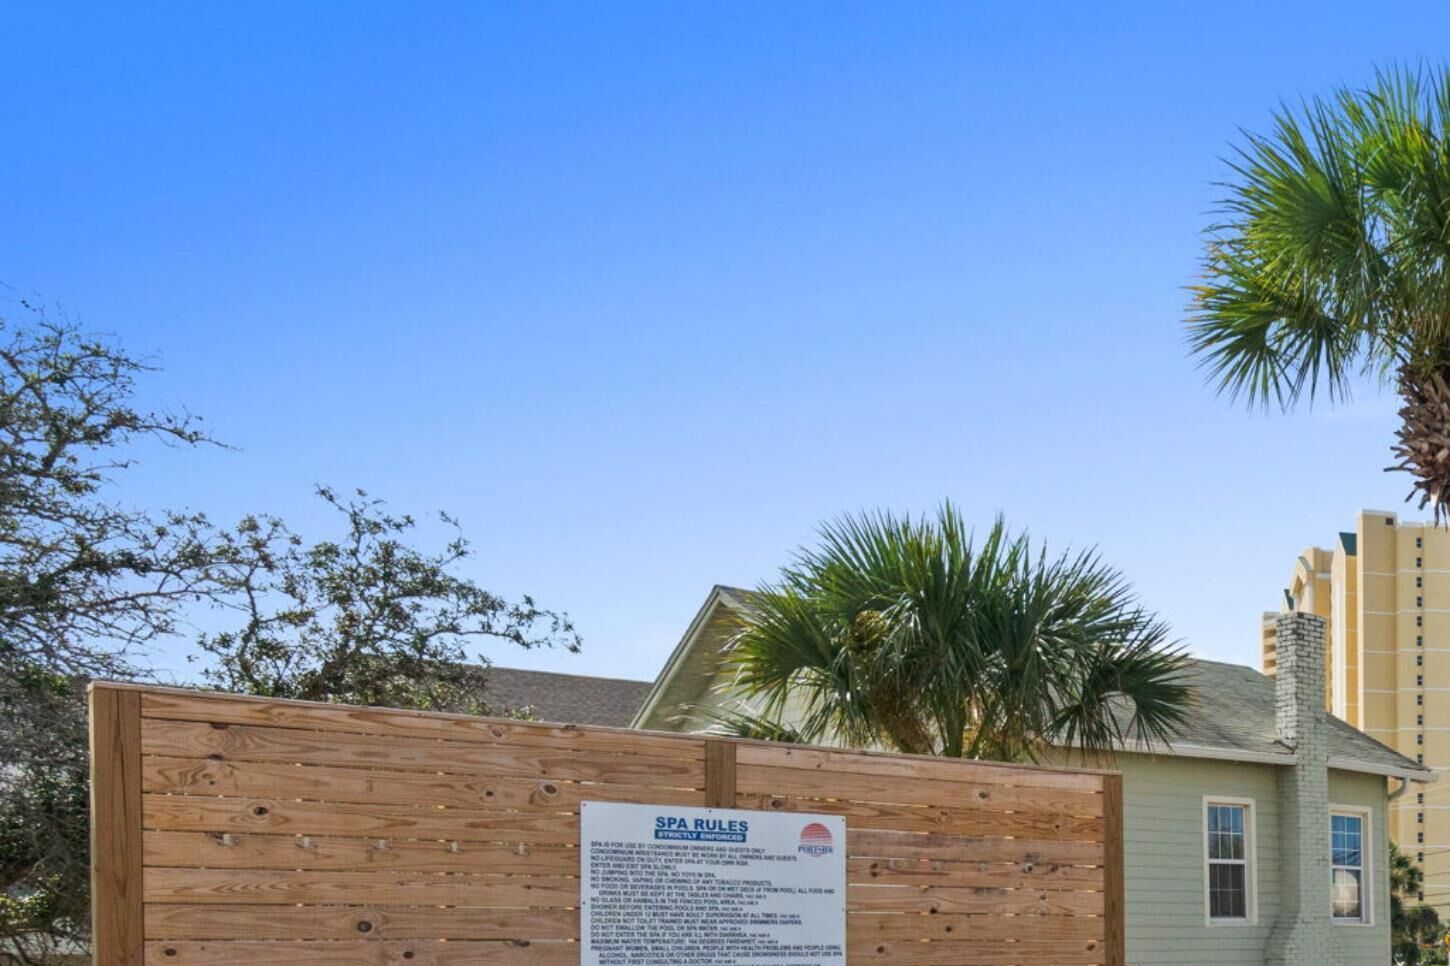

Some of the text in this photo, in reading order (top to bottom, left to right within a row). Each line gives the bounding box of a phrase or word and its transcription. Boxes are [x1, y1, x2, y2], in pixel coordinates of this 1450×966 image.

[656, 817, 748, 832] SPA RULES
[658, 831, 743, 841] STRICTLY ENFORCED
